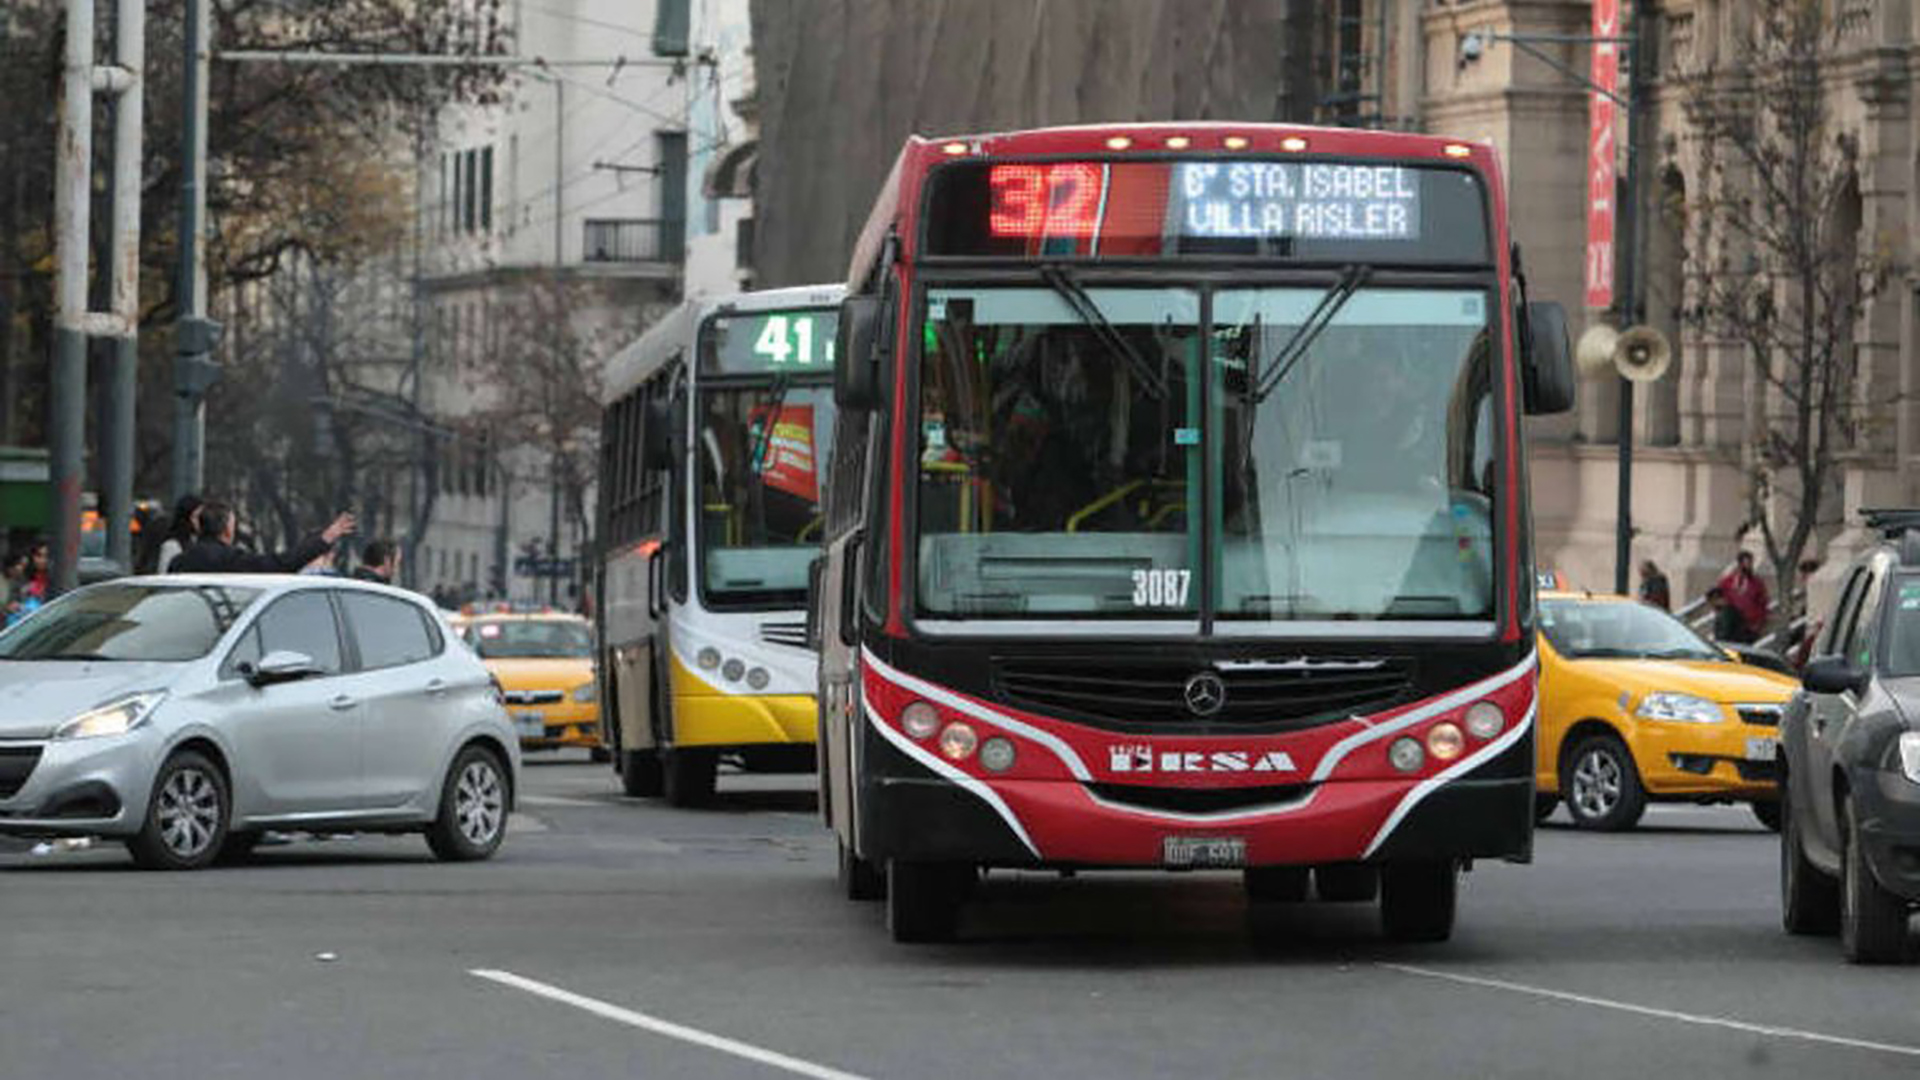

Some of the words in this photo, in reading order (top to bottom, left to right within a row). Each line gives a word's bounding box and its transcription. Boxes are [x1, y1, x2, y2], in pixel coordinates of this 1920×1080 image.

[990, 164, 1099, 235] 32
[1229, 164, 1294, 197] STA.
[1304, 165, 1413, 198] ISABEL
[1187, 203, 1283, 234] VILLA
[754, 316, 812, 363] 41
[1132, 569, 1190, 606] 3087
